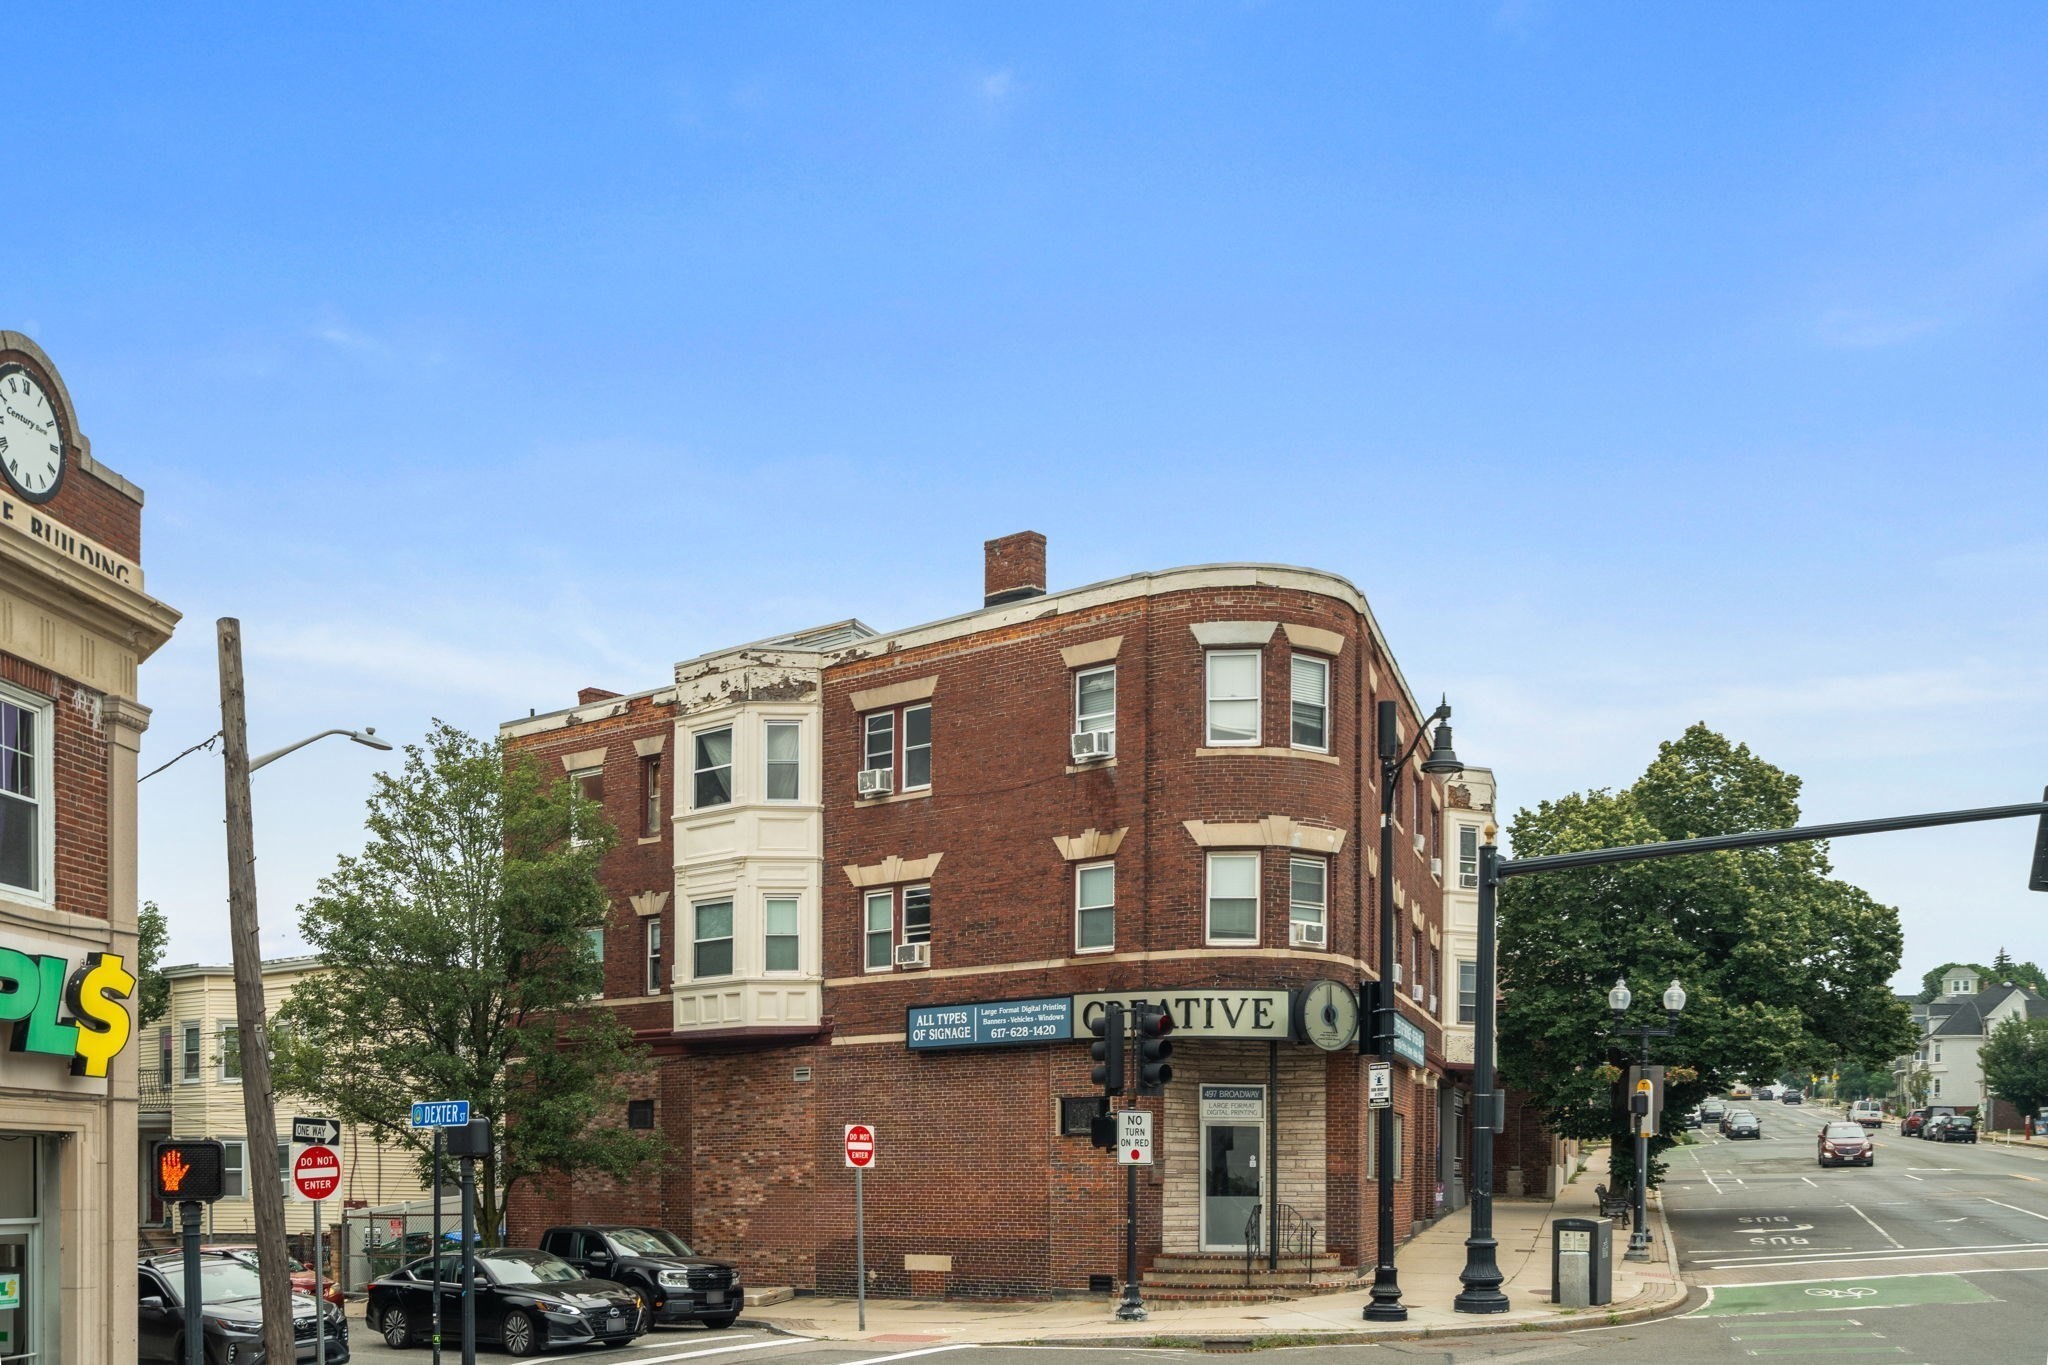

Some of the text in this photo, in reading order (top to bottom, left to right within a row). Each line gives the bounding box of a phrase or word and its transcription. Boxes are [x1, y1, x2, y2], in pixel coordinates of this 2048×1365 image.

[6, 406, 35, 429] Century
[981, 1003, 1067, 1016] Large Format Digital Printing
[1083, 998, 1275, 1030] CATIVE
[916, 1012, 967, 1027] ALL TYPES
[982, 1013, 1065, 1025] Banners Vehicles Windows
[912, 1026, 971, 1041] OF SIGNAGE
[991, 1025, 1056, 1038] 617-628-1420
[1204, 1090, 1260, 1098] 497 BROADWAY
[424, 1104, 466, 1124] DEXTER ST
[1127, 1115, 1143, 1125] NO
[296, 1124, 327, 1137] ONE WAY
[1125, 1127, 1145, 1136] TURN
[1120, 1138, 1150, 1147] ON RED
[300, 1156, 334, 1167] DO NOT
[304, 1180, 332, 1190] ENTER
[1749, 1236, 1810, 1245] BUS
